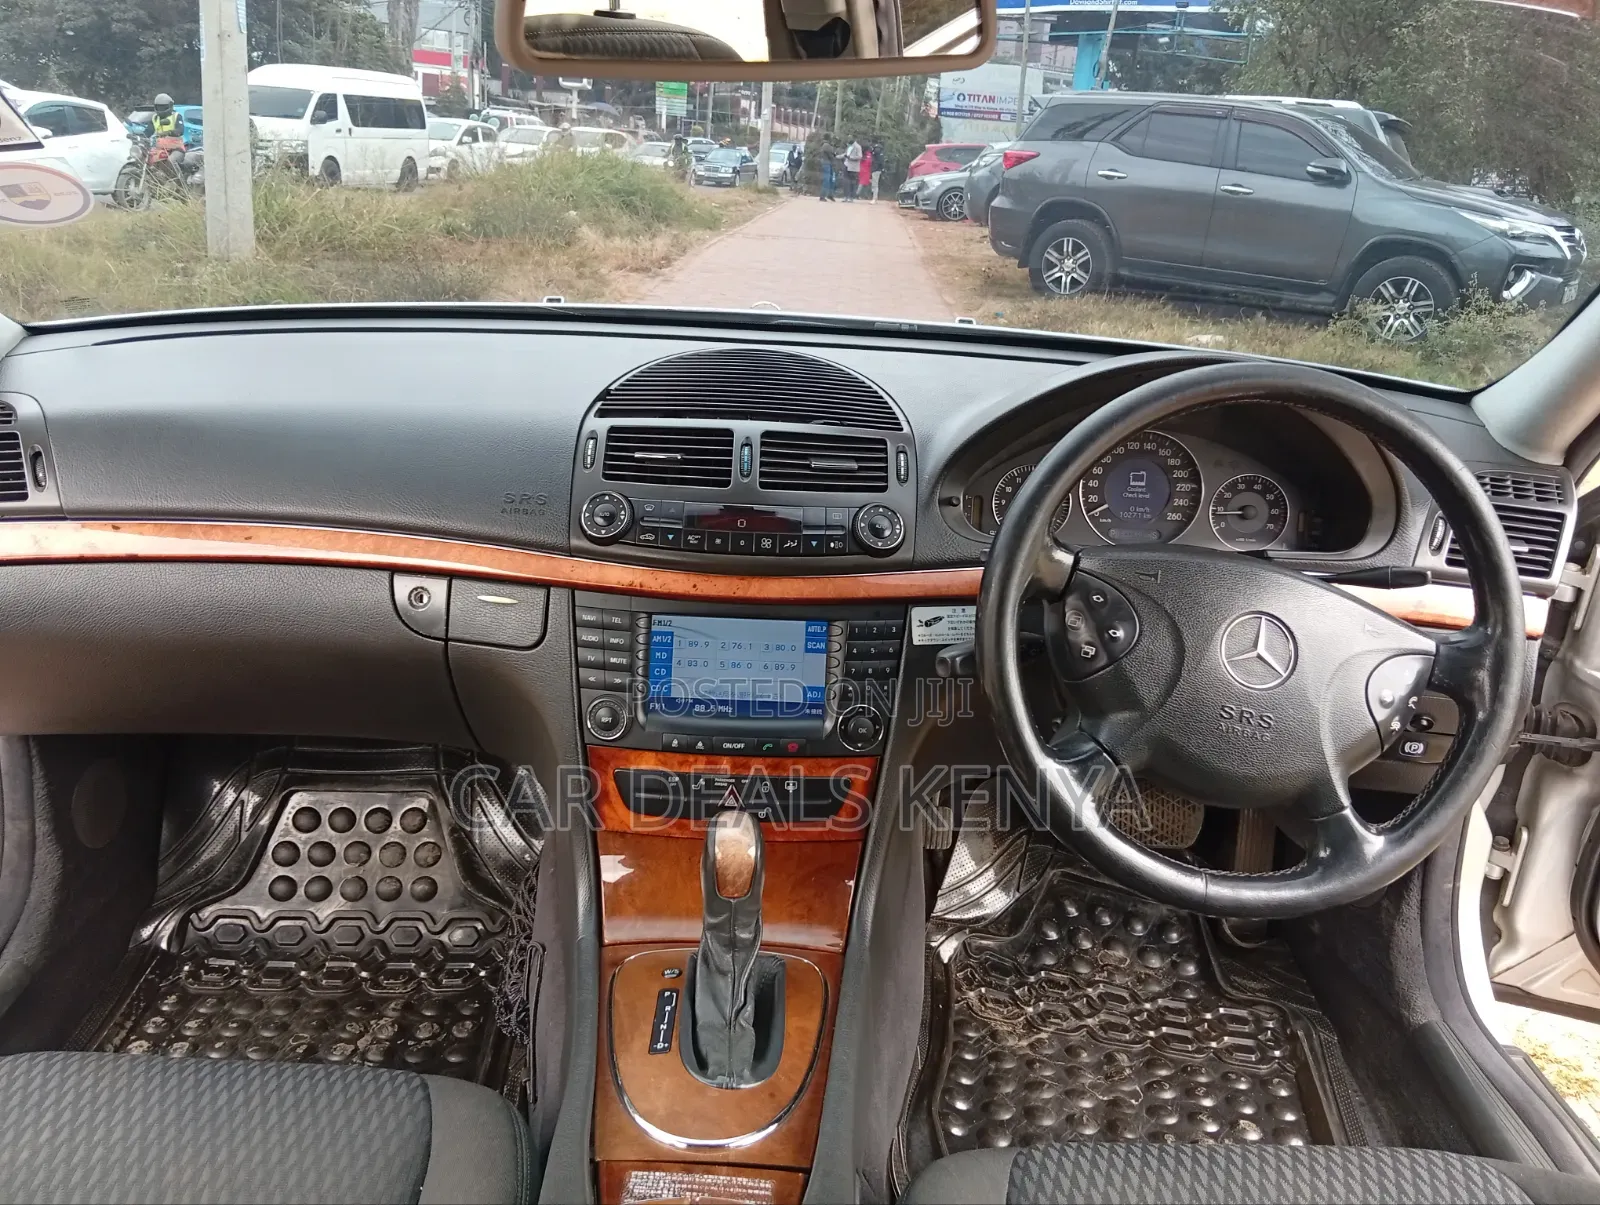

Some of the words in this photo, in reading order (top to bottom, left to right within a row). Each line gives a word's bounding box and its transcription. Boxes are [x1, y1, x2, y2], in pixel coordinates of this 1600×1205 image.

[967, 93, 996, 104] TITAN
[502, 492, 548, 505] SRS
[500, 508, 546, 516] AIRBAG
[1166, 512, 1182, 520] 260
[1220, 704, 1274, 729] SRS
